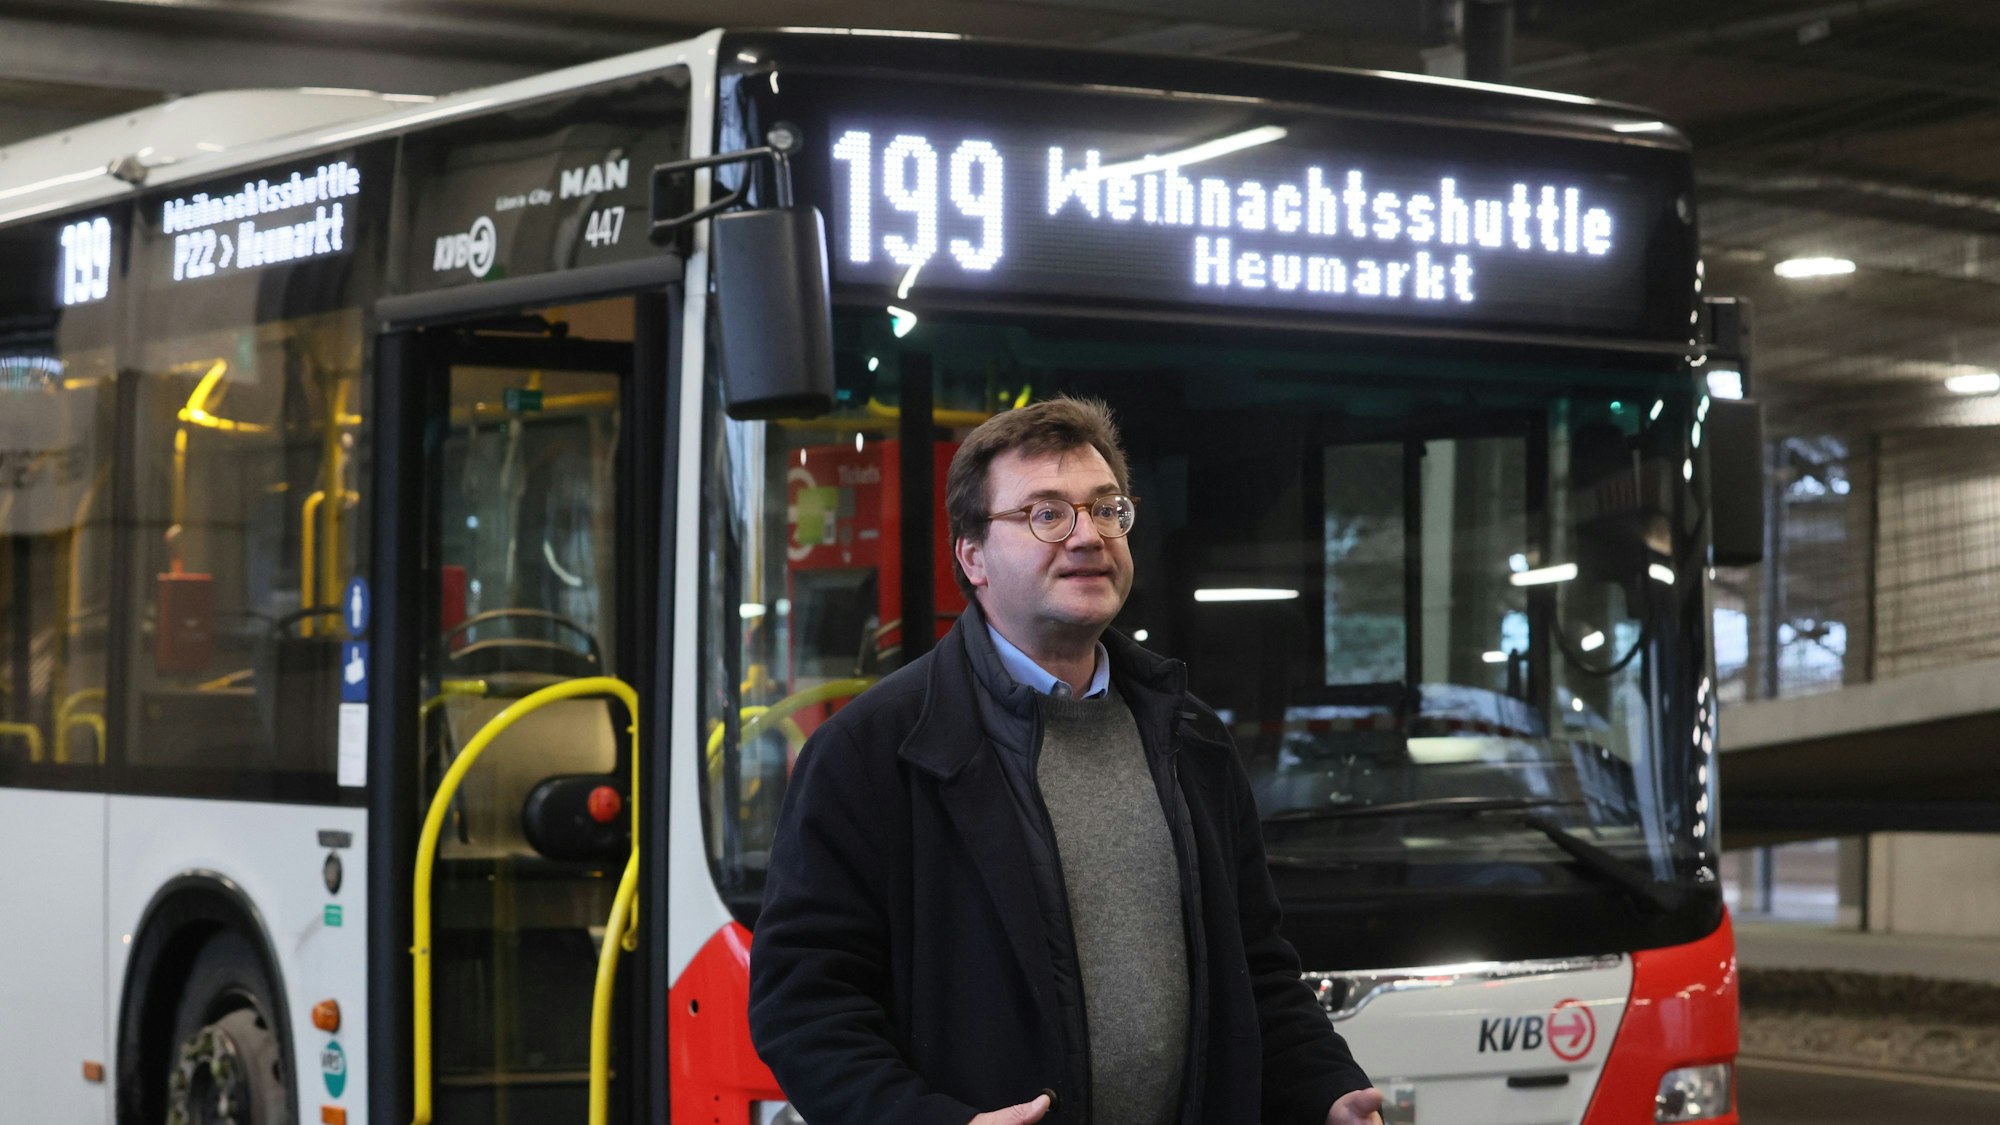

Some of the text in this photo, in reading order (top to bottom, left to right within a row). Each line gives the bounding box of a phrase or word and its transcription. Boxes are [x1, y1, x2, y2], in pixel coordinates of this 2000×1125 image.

[163, 161, 360, 234] Weihnachtsshuttle
[528, 189, 553, 207] City
[560, 159, 629, 199] MAN
[832, 130, 1003, 270] 199
[1047, 146, 1613, 255] Weihnachtsshuttle
[173, 230, 217, 282] P22
[236, 202, 344, 269] Heumarkt
[433, 232, 470, 271] KVB
[585, 206, 625, 247] 447
[61, 216, 111, 305] 199
[1194, 237, 1475, 303] Heumarkt
[1479, 1016, 1544, 1053] KVB
